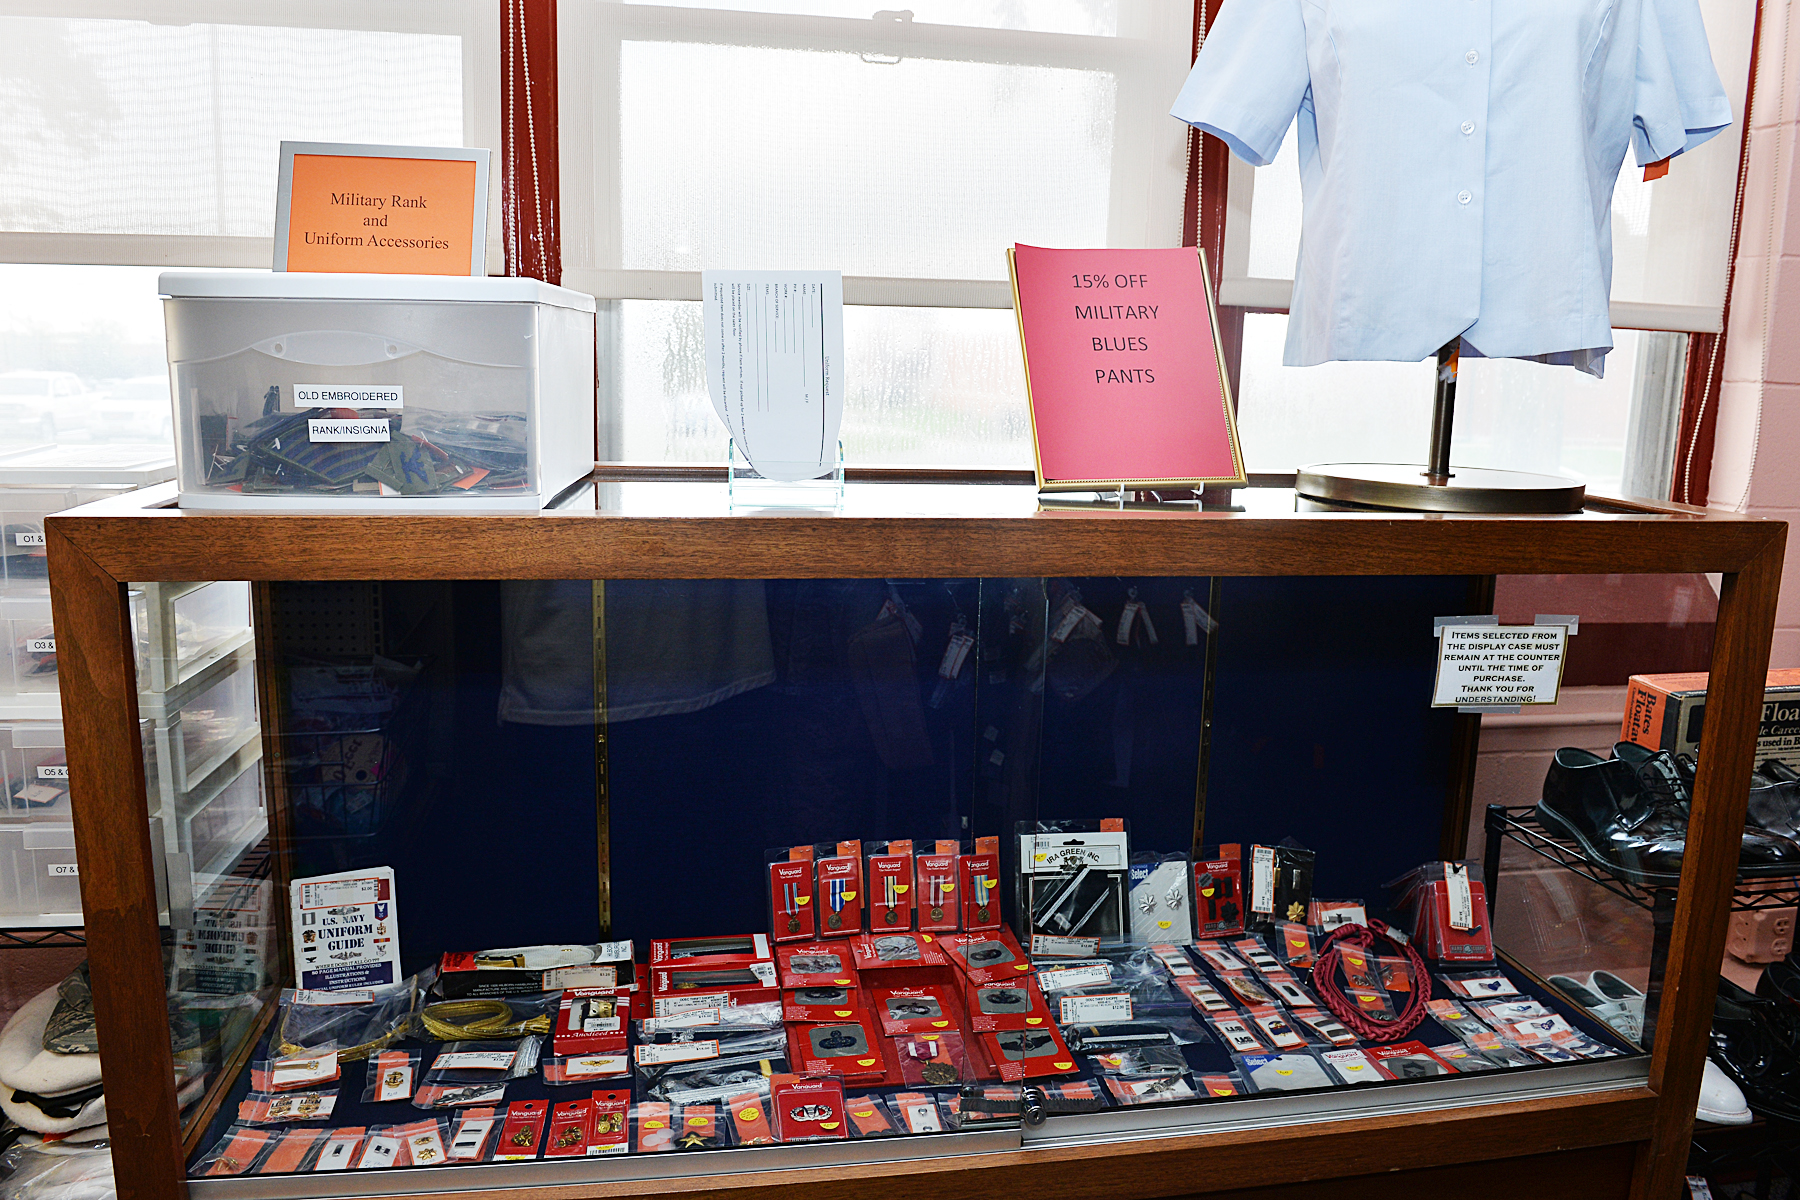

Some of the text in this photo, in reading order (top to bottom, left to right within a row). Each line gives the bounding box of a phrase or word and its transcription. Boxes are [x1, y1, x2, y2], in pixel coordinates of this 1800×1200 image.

[331, 191, 427, 209] Military Rank
[364, 213, 388, 228] and
[304, 231, 449, 250] Uniform Accessories
[1072, 274, 1148, 289] 15% OFF
[1075, 305, 1159, 320] MILITARY
[1092, 337, 1148, 351] BLUES
[1095, 369, 1155, 383] PANTS
[298, 390, 398, 402] OLD EMBROIDERED
[312, 424, 388, 437] RANK/INSIGNIA
[1455, 695, 1537, 703] UNDERSTANDING!
[1642, 692, 1657, 735] Bates
[1762, 737, 1782, 746] used
[1783, 737, 1792, 745] in
[1046, 854, 1060, 864] IRA
[826, 863, 853, 872] Vanguard
[877, 860, 902, 869] Vanguard
[925, 860, 949, 869] Vanguard
[1206, 862, 1228, 870] Vanguard
[779, 867, 803, 876] Vanguard
[1130, 869, 1149, 880] Select
[322, 914, 365, 926] U.S. NAVY
[318, 924, 373, 939] UNIFORM
[327, 938, 365, 951] GUIDE
[324, 971, 364, 980] ILLUSTRATIONS
[329, 977, 366, 985] INSTRUCTIONS
[574, 989, 615, 997] Vanguard
[595, 1099, 627, 1108] Vanguard
[511, 1109, 542, 1117] Vanguard
[556, 1108, 587, 1118] Vanguard
